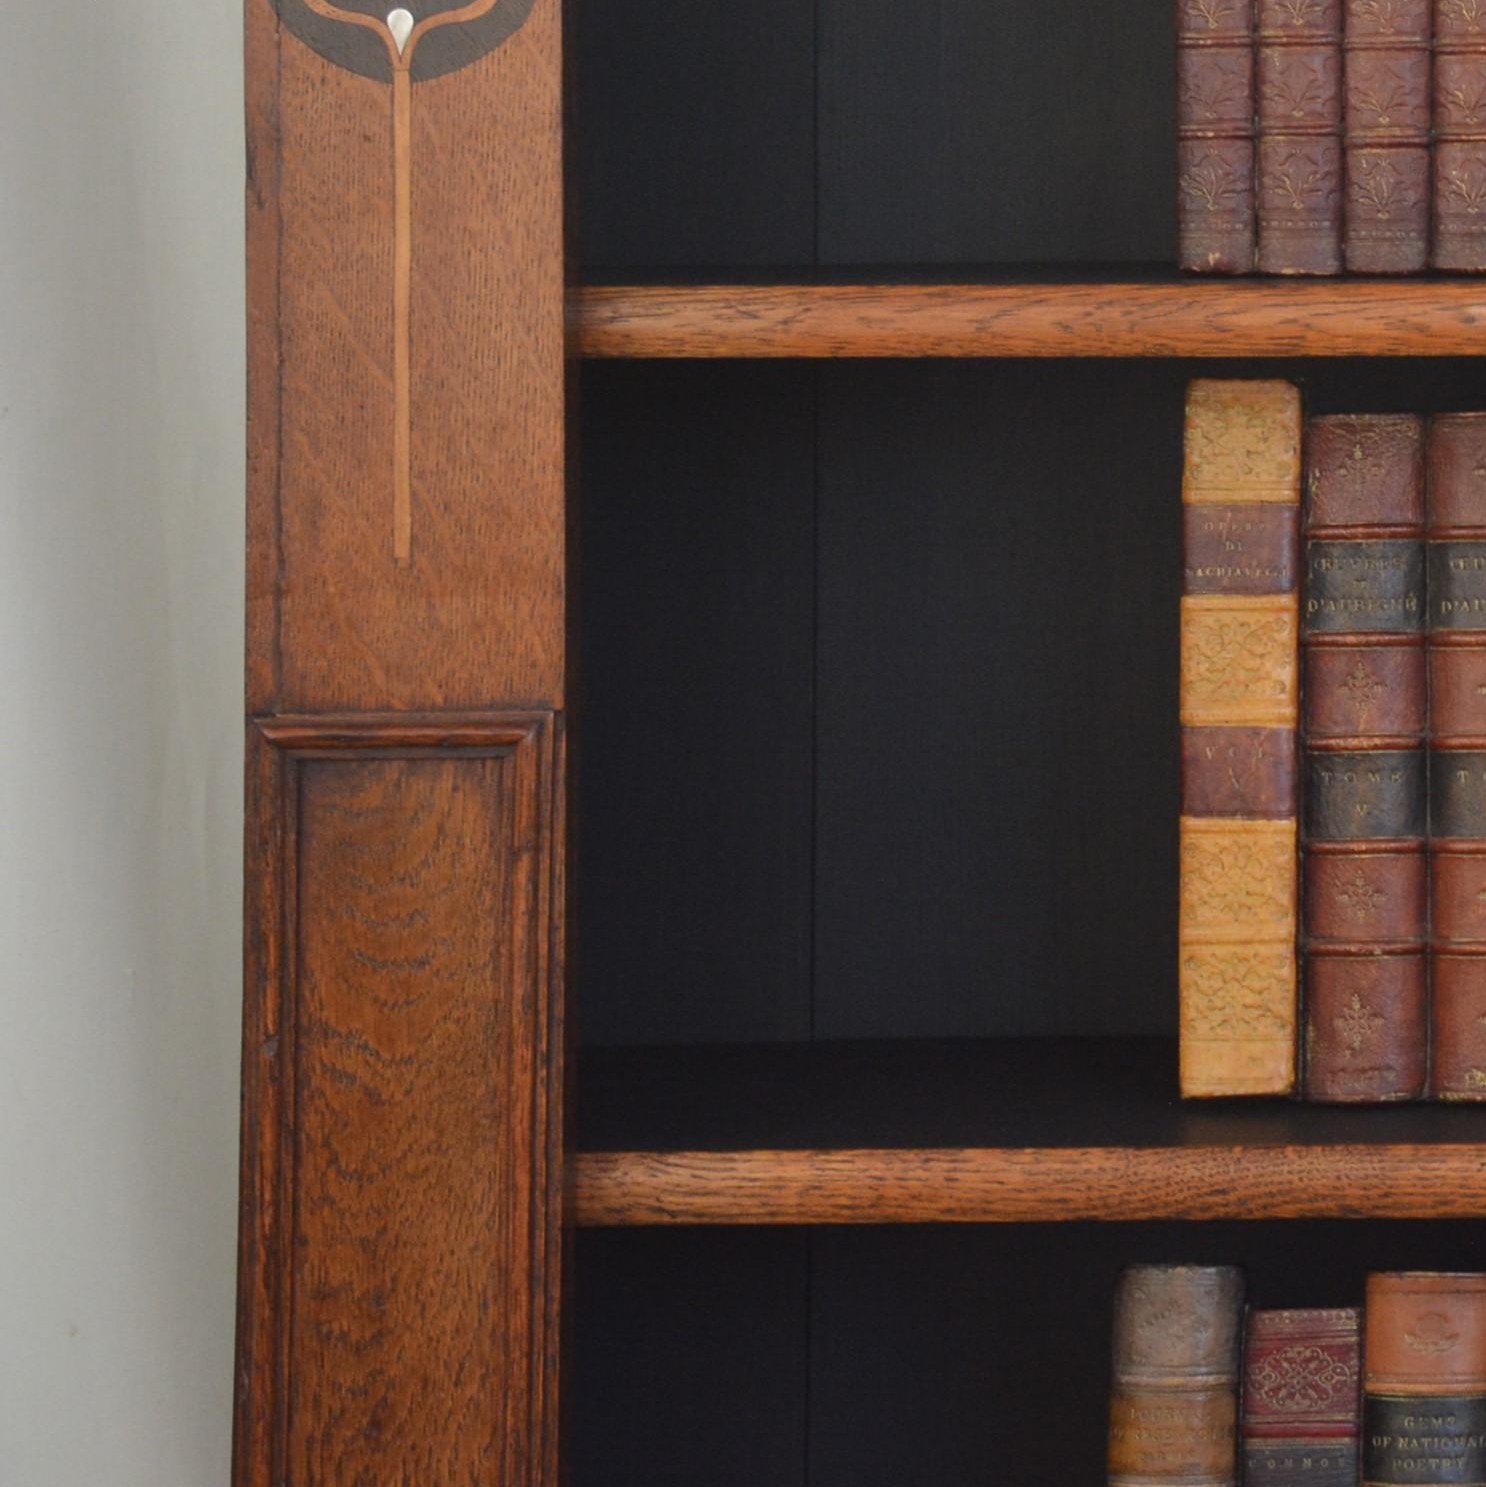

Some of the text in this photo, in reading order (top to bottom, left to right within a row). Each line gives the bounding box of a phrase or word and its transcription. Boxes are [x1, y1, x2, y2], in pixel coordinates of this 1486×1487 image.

[1321, 771, 1402, 786] TOME
[1371, 1435, 1393, 1450] OF
[1391, 1456, 1468, 1471] POETRY
